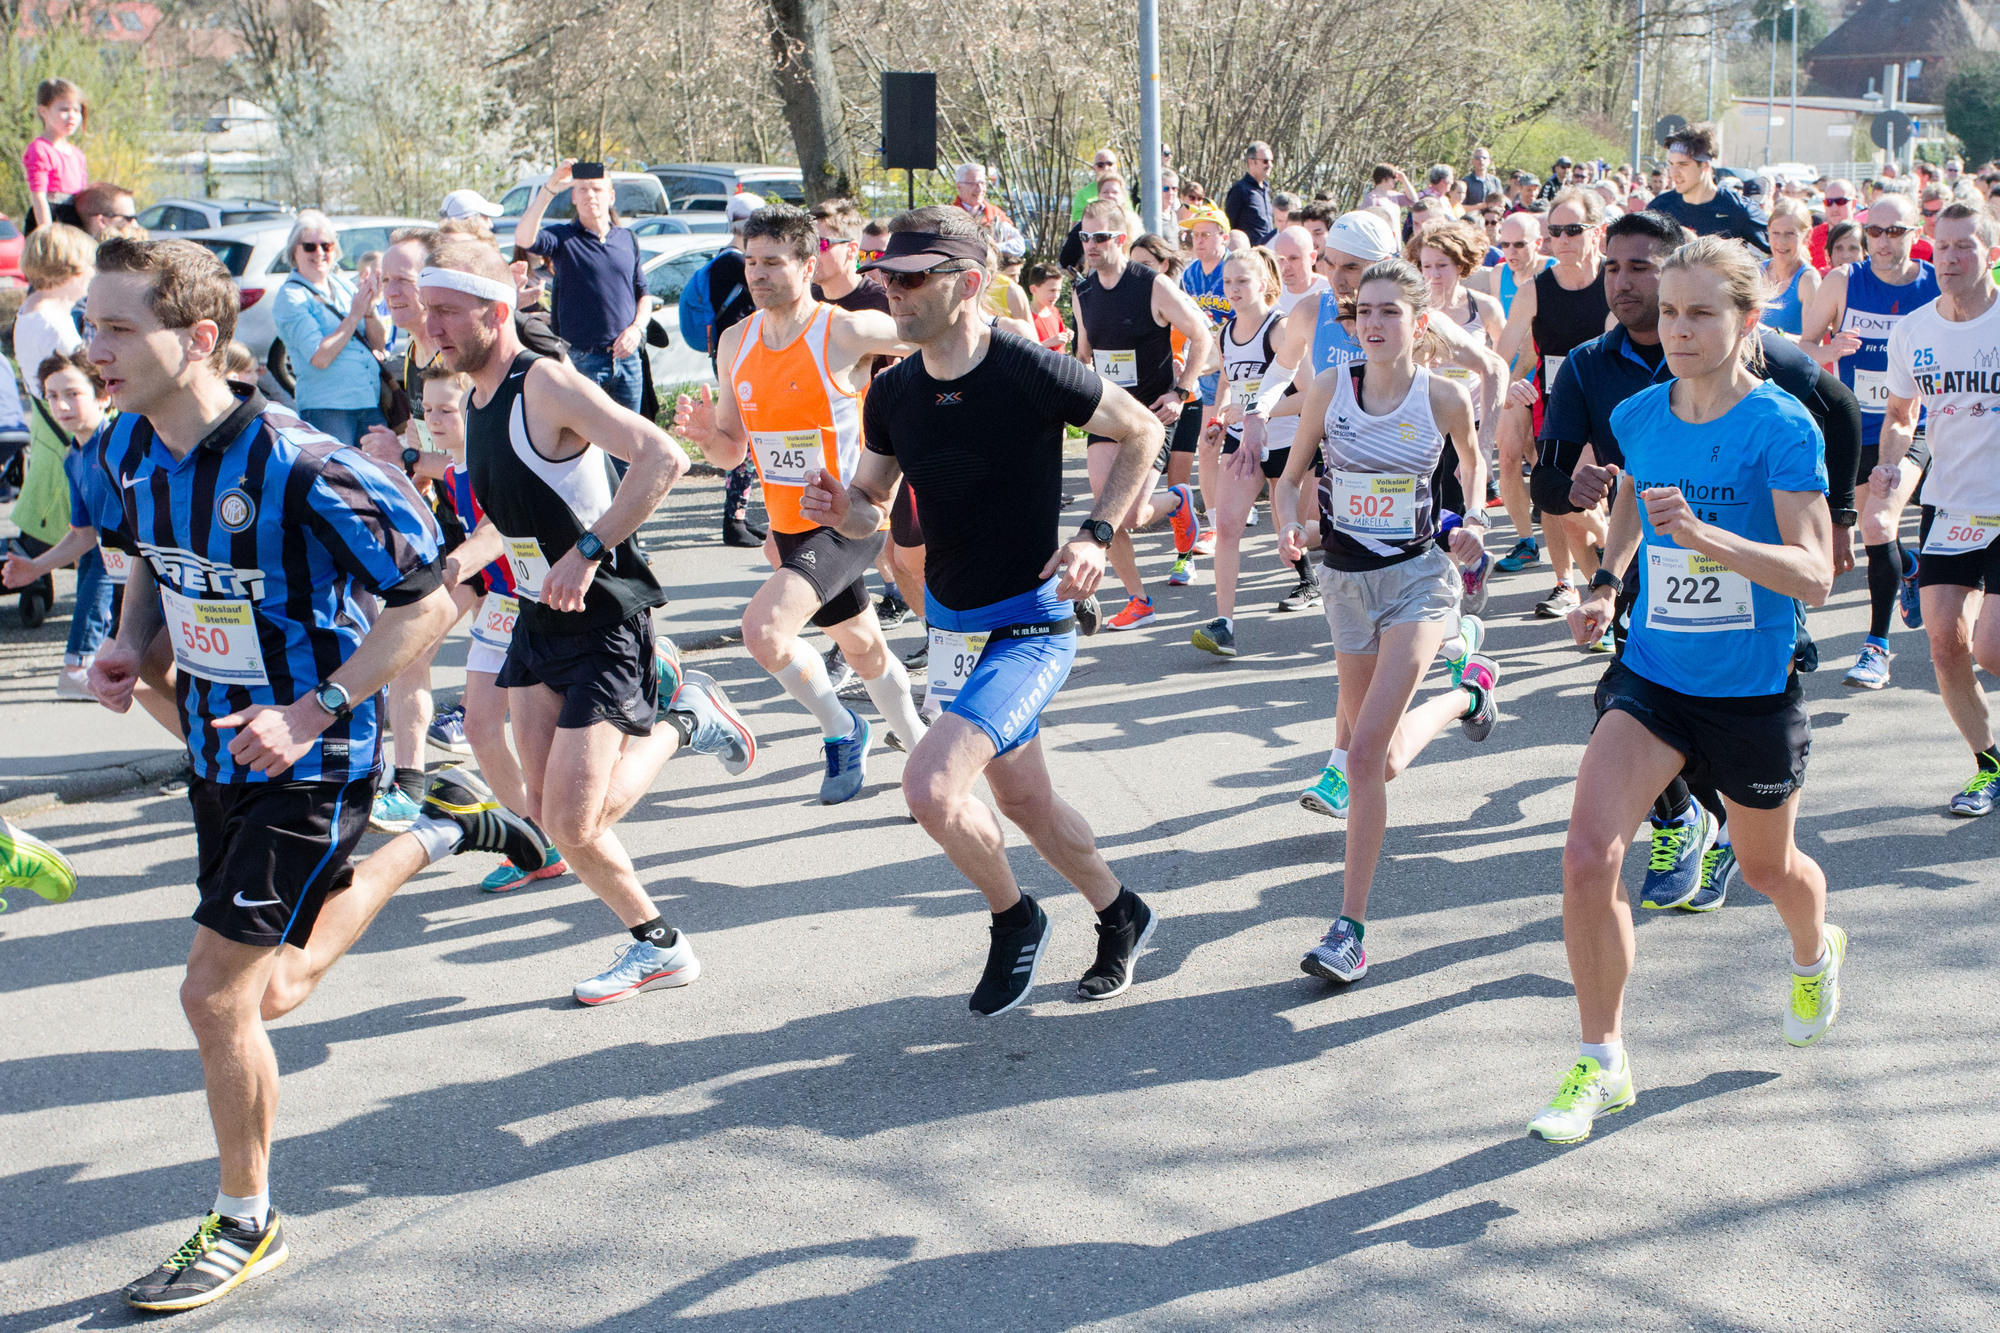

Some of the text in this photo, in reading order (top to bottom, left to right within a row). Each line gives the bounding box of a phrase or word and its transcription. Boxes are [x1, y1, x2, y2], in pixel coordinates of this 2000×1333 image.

[1913, 347, 1938, 367] 25.
[1104, 363, 1120, 376] 44
[786, 434, 816, 442] Volkslauf
[770, 450, 806, 469] 245
[1376, 478, 1410, 486] Volkslauf
[1349, 494, 1395, 518] 502
[1946, 526, 1986, 542] 506
[1699, 565, 1733, 573] Stette
[1666, 576, 1722, 604] 222
[196, 604, 242, 614] Volkslauf
[204, 615, 240, 624] Stetten
[181, 621, 230, 656] 550
[953, 654, 976, 678] 93
[1002, 659, 1061, 739] skinfit
